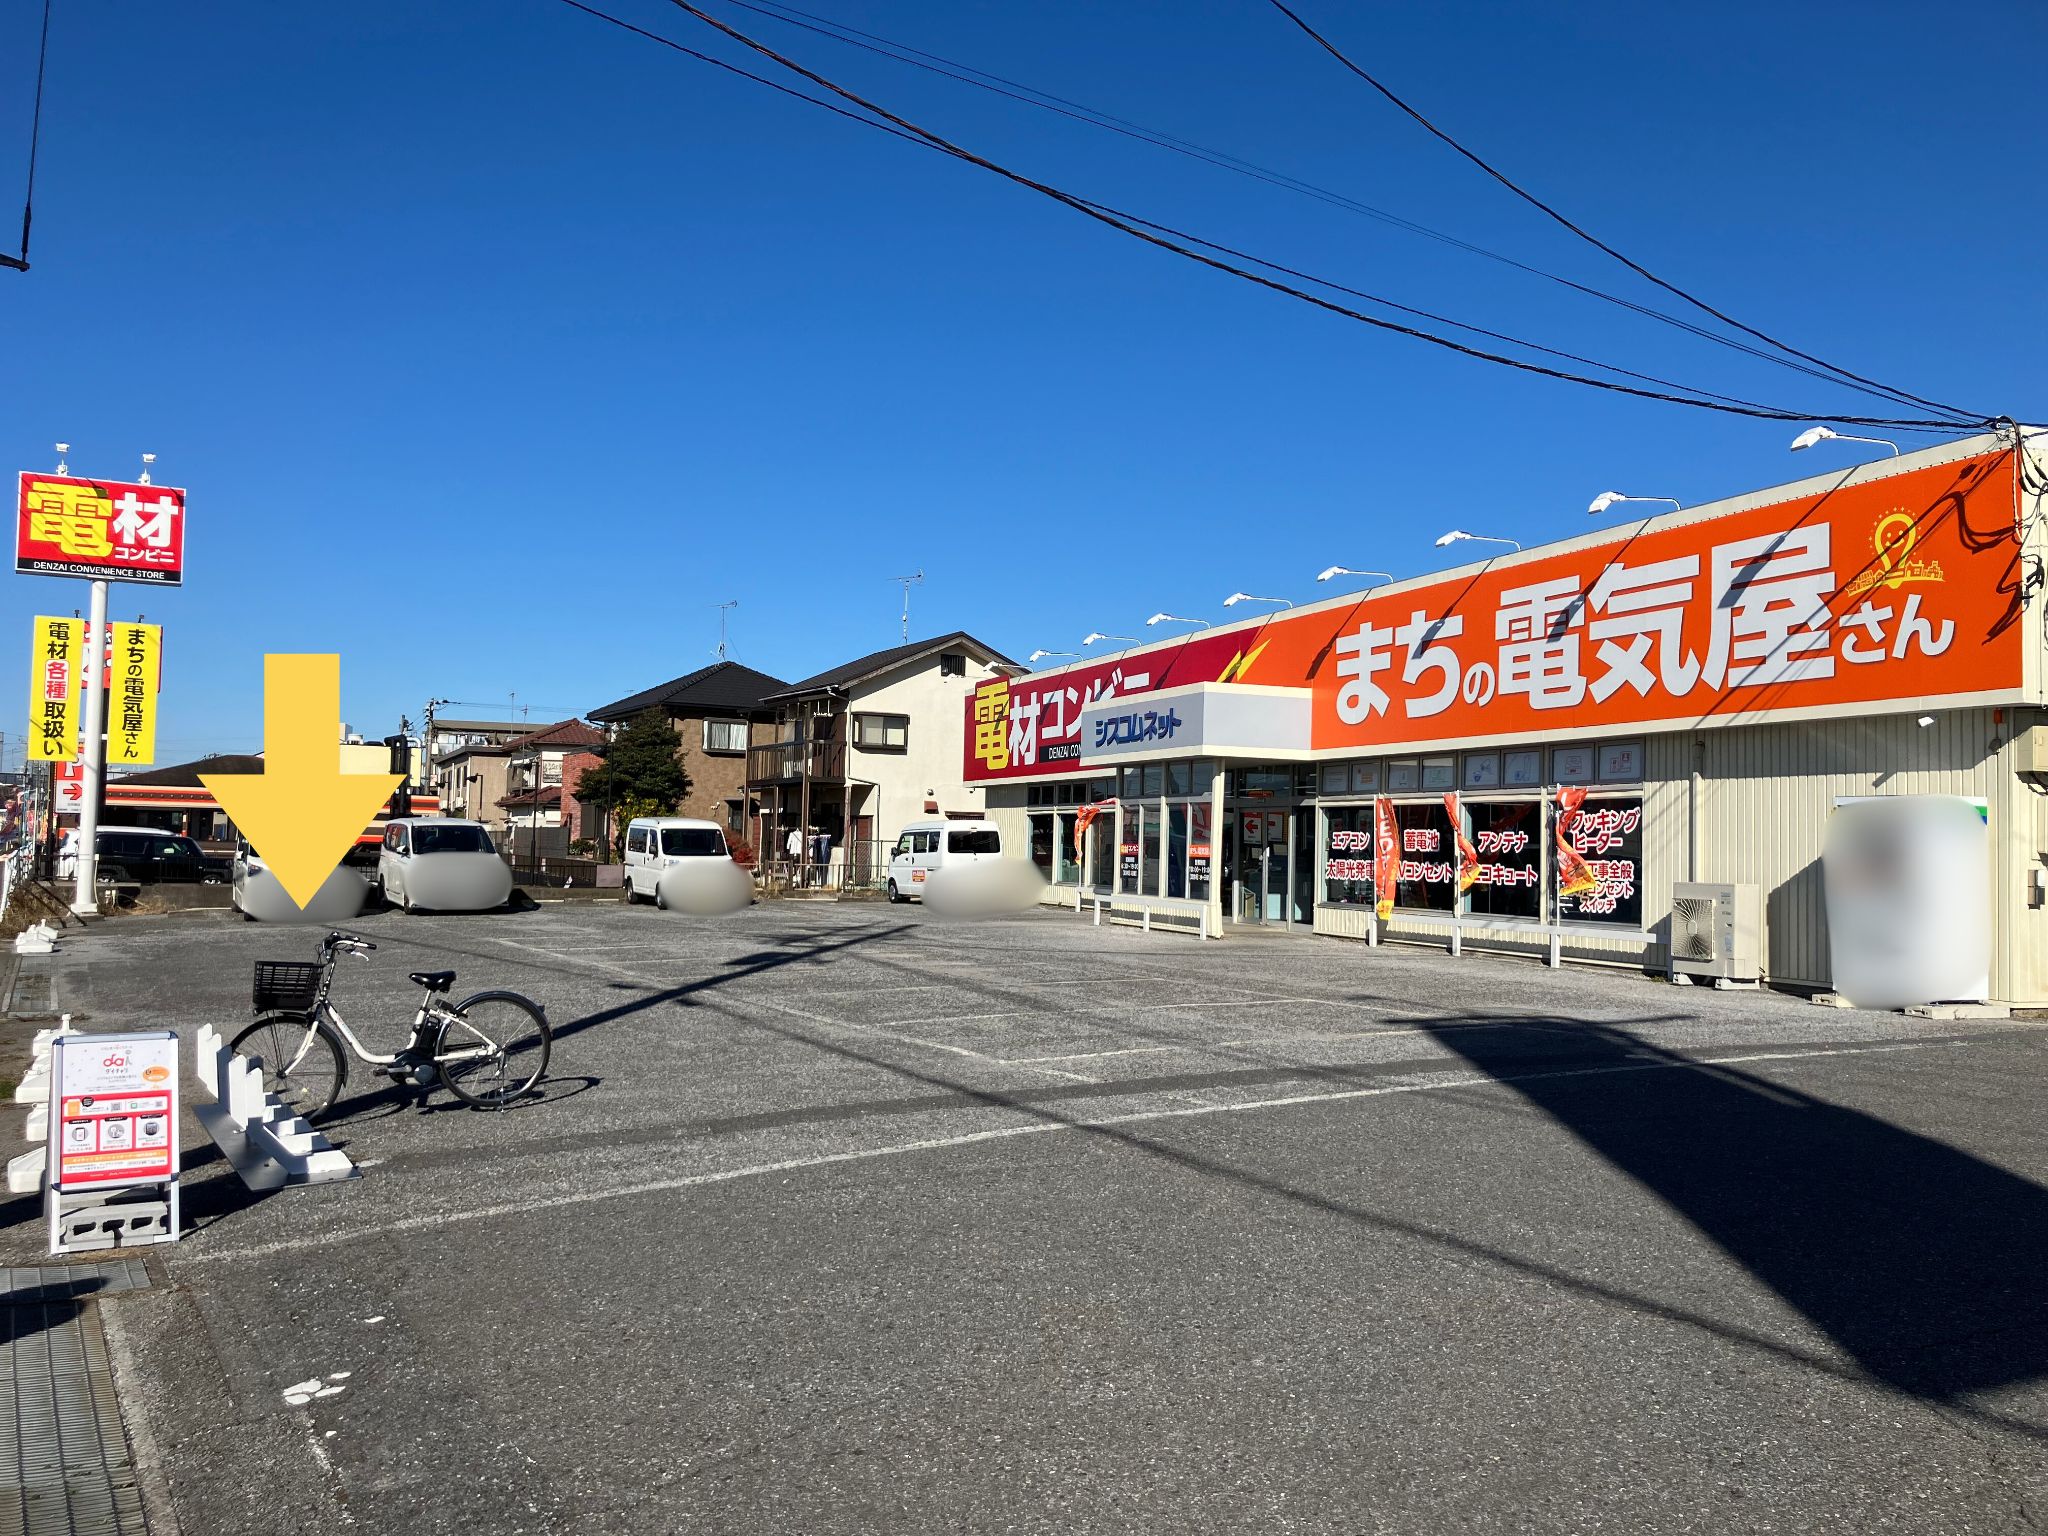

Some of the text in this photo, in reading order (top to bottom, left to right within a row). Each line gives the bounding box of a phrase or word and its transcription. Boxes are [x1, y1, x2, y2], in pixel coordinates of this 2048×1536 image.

[28, 481, 178, 558] 電材
[115, 547, 174, 563] コンビニ
[33, 561, 165, 579] DENZAI CONVENIENCE STORE
[1336, 522, 1955, 725] まちの電気屋さん
[43, 622, 70, 756] 電材各種取扱い
[121, 629, 146, 758] まちの電気屋さん
[1095, 707, 1182, 748] シスコムネット
[1049, 746, 1069, 760] DENZAI
[1569, 806, 1642, 835] クッキング
[1331, 831, 1371, 850] エアコン
[1403, 829, 1440, 852] 蓄電池
[1477, 831, 1528, 853] アンテナ
[1572, 832, 1624, 855] ヒーター
[1325, 859, 1375, 881] 太陽光発電
[1397, 861, 1455, 884] Vコンセント
[1474, 863, 1538, 888] コキュート
[1583, 860, 1635, 881] 工事全般
[1578, 897, 1617, 914] スイッチ
